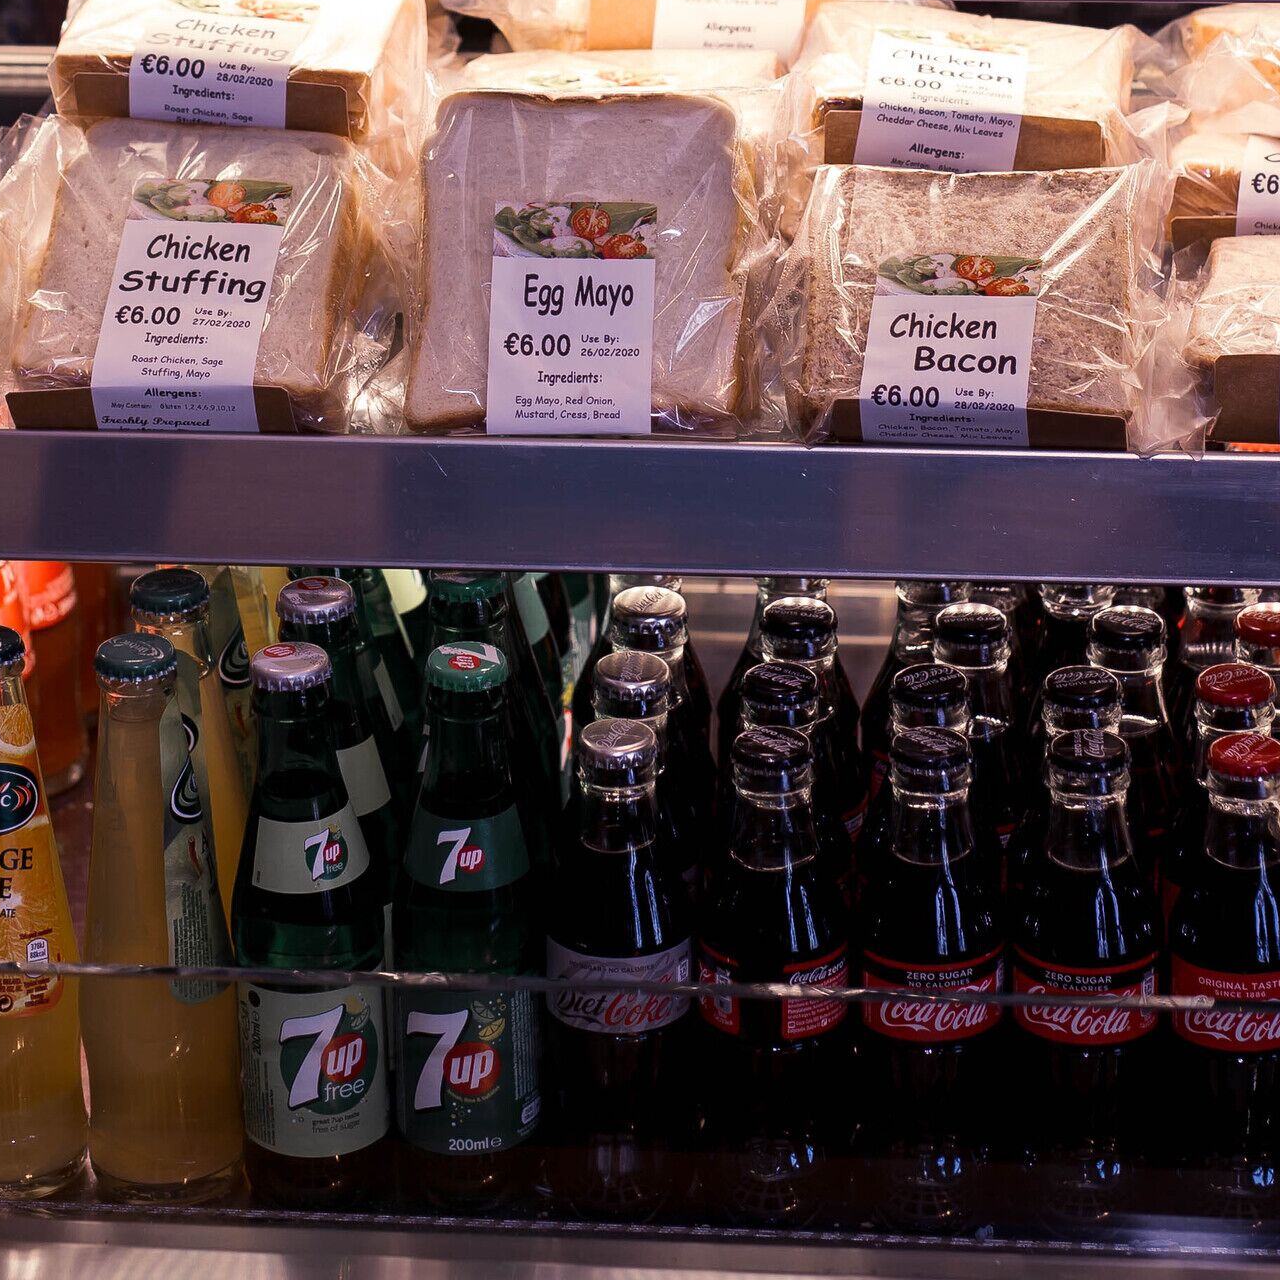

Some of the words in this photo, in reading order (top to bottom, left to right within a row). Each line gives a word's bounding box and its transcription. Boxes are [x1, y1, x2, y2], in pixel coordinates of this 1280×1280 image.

[175, 19, 276, 39] Chicken
[145, 32, 291, 62] Stuffing
[140, 53, 206, 79] €6.00
[892, 49, 992, 69] Chicken
[216, 73, 273, 87] 28/02/2020
[879, 76, 942, 90] €6.00
[917, 63, 1013, 84] Bacon
[172, 84, 235, 101] Ingredients:
[909, 143, 965, 160] Allergens:
[146, 233, 251, 263] Chicken
[119, 269, 267, 303] Stuffing
[524, 273, 565, 316] Egg
[574, 275, 634, 316] Mayo
[115, 305, 181, 326] €6.00
[192, 318, 251, 329] 27/02/2020
[889, 312, 998, 340] Chicken
[144, 332, 209, 345] Ingredients:
[503, 332, 571, 357] €6.00
[580, 348, 640, 358] 26/02/2020
[913, 346, 1017, 375] Bacon
[537, 370, 603, 386] Ingredients:
[144, 387, 202, 399] Allergens:
[515, 395, 533, 407] Egg
[534, 396, 563, 407] Mayo,
[565, 396, 584, 405] Red
[585, 396, 616, 407] Onion,
[871, 384, 940, 408] €6.00
[515, 409, 558, 420] Mustard,
[560, 410, 591, 421] Cress,
[593, 410, 621, 420] Bread
[954, 401, 1015, 412] 28/02/2020
[909, 413, 976, 423] Ingredients:
[304, 828, 341, 881] 7up
[436, 827, 484, 885] 7up
[827, 961, 844, 978] zero
[907, 970, 936, 981] ZERO
[938, 967, 973, 980] SUGAR
[1045, 972, 1071, 983] ZERO
[1075, 974, 1112, 984] SUGAR
[1198, 976, 1252, 991] ORIGINAL
[278, 1004, 361, 1109] 7up
[406, 1009, 495, 1112] 7up
[324, 1077, 366, 1104] free
